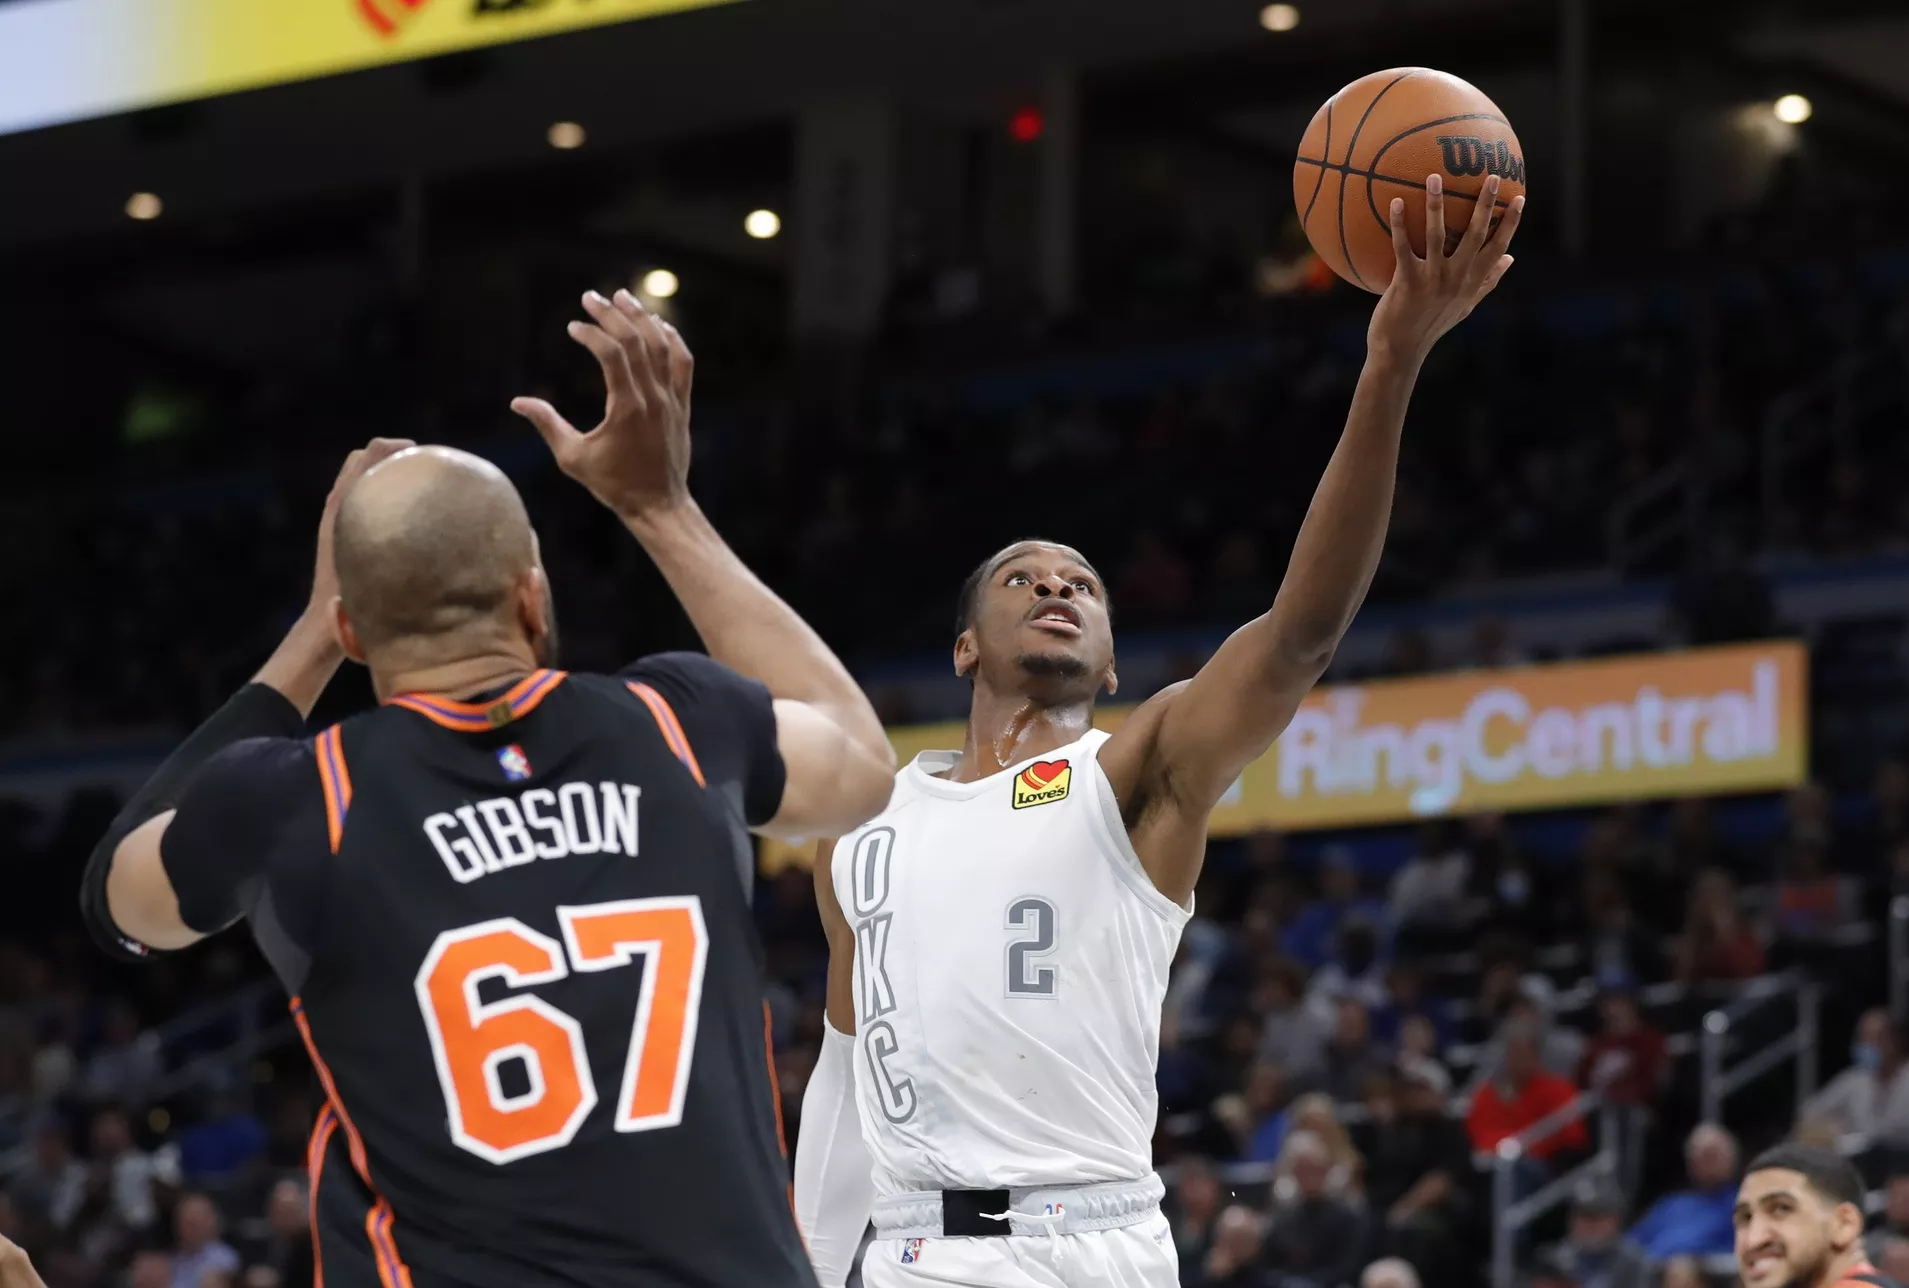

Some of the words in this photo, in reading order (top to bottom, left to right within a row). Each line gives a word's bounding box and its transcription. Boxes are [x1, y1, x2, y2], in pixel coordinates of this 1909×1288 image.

[1277, 659, 1780, 817] RingCentral
[423, 781, 641, 884] GIBSON
[851, 825, 918, 1125] OKC
[1003, 894, 1060, 1000] 2
[413, 894, 710, 1166] 67
